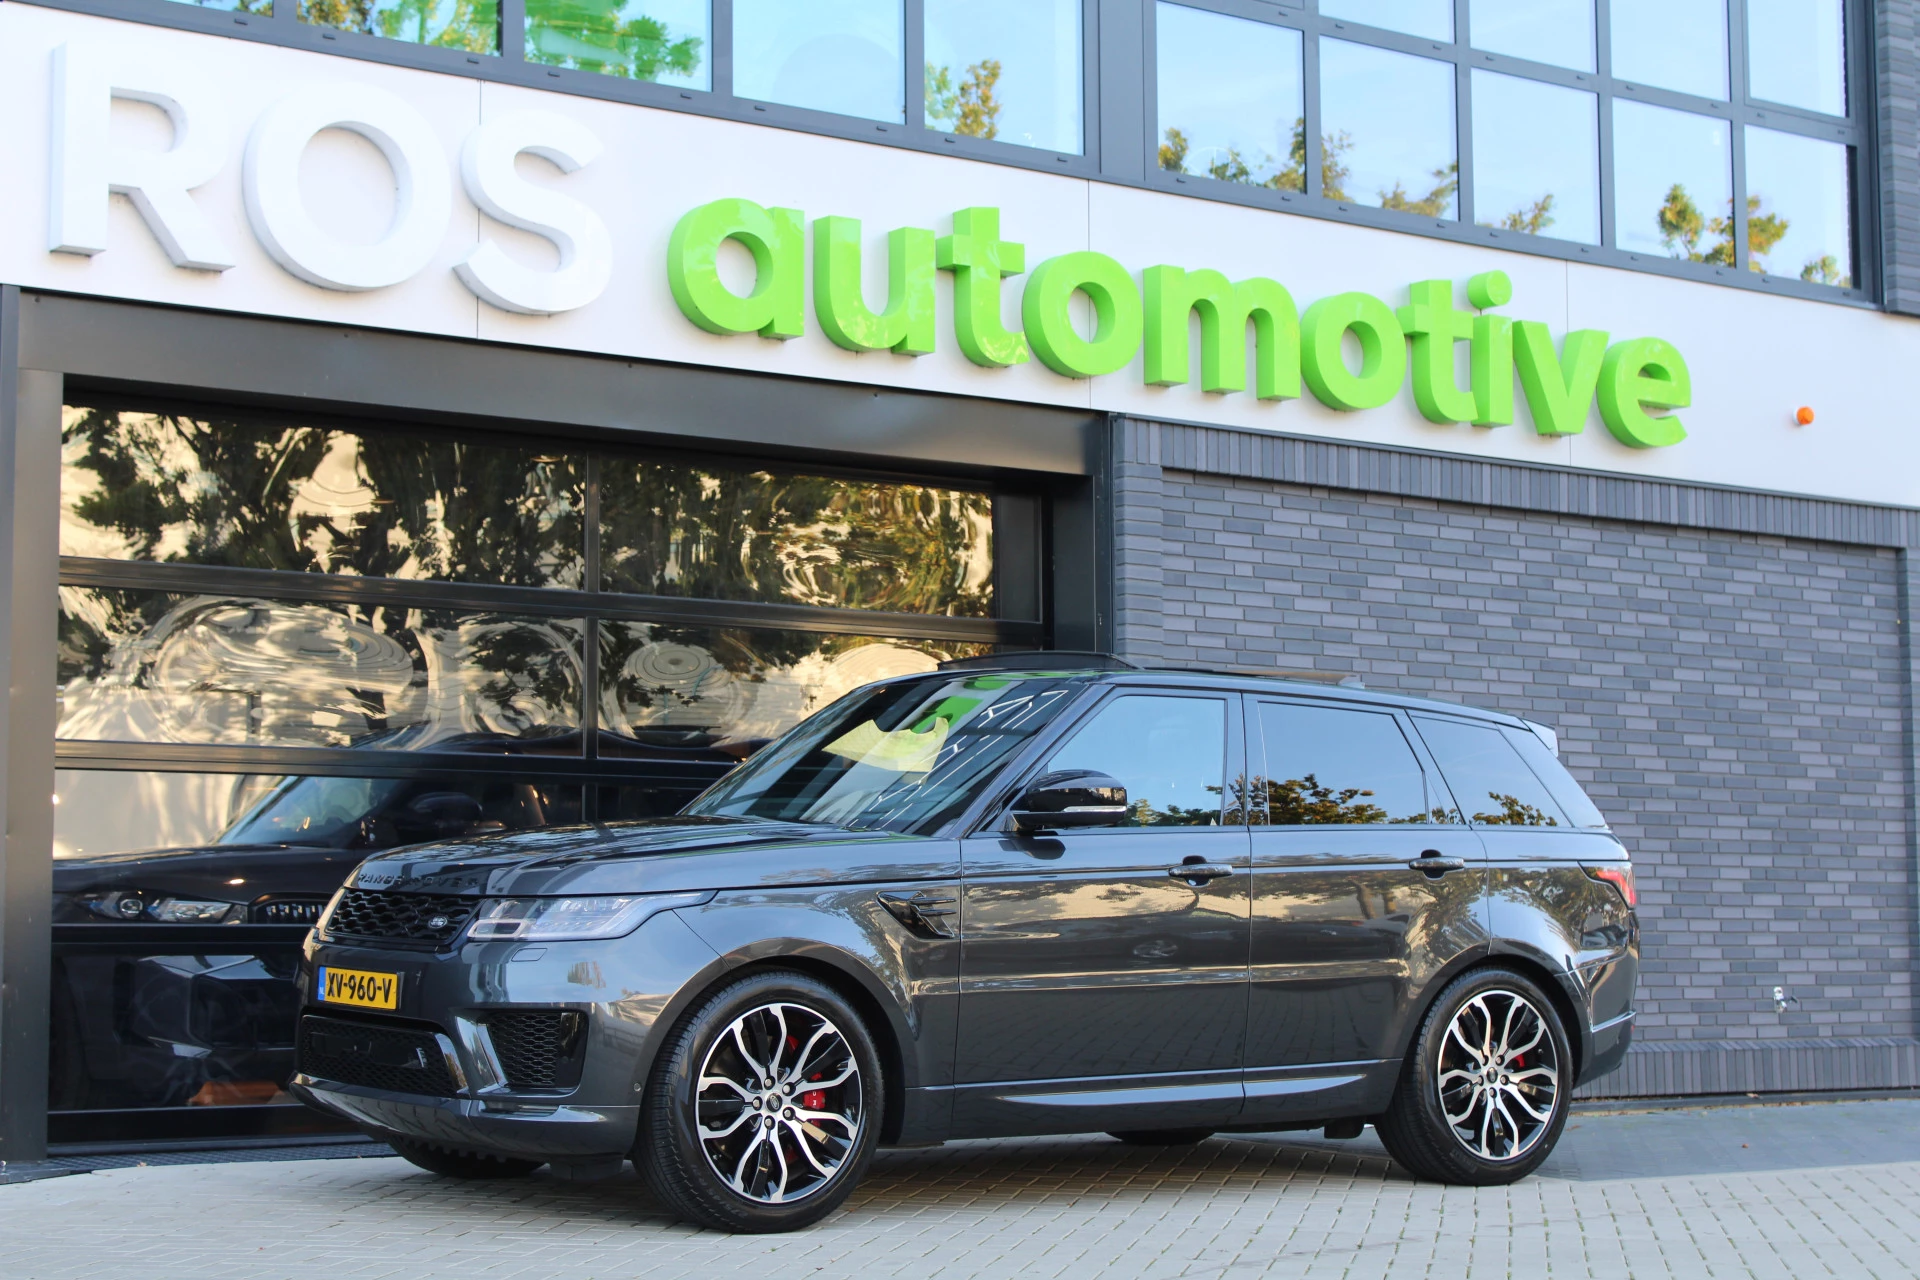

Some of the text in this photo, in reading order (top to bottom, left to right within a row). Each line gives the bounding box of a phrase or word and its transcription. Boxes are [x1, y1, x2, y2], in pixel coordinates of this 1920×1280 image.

[49, 42, 1692, 449] ROS automotive
[327, 972, 393, 1004] XV-960-V
